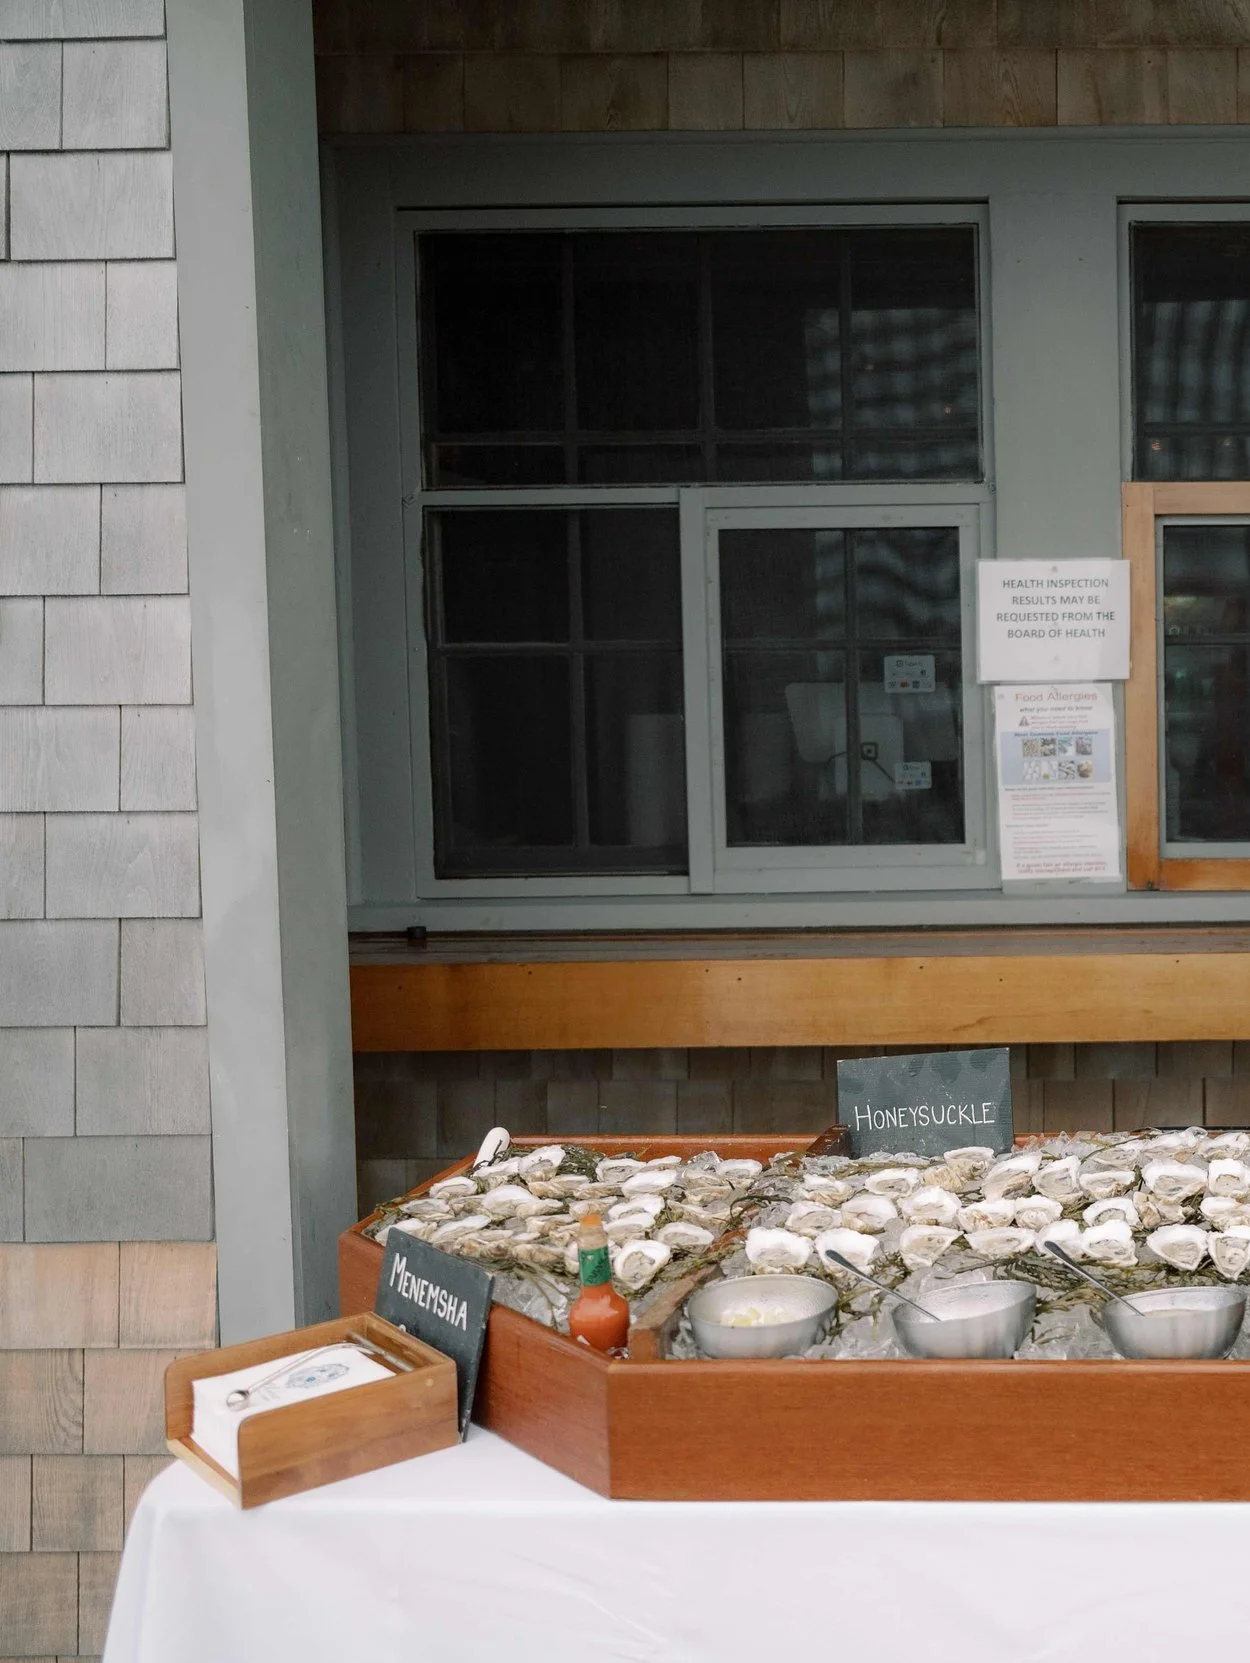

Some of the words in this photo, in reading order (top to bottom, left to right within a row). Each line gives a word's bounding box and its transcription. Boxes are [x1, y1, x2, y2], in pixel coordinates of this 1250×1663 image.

[1003, 579, 1043, 589] HEALTH
[1046, 578, 1109, 589] INSPECTION
[1012, 596, 1057, 605] RESULTS
[1060, 596, 1084, 605] MAY
[1087, 595, 1100, 604] BE
[996, 612, 1059, 623] REQUESTED
[1062, 612, 1093, 621] FROM
[1096, 611, 1116, 621] THE
[1007, 629, 1045, 638] BOARD
[1048, 629, 1063, 638] OF
[1065, 628, 1105, 638] HEALTH
[1015, 692, 1043, 702] Food
[1047, 691, 1097, 703] Allergies
[854, 1102, 996, 1131] HONEYSUCKLE
[389, 1252, 469, 1332] MENEMSHA
